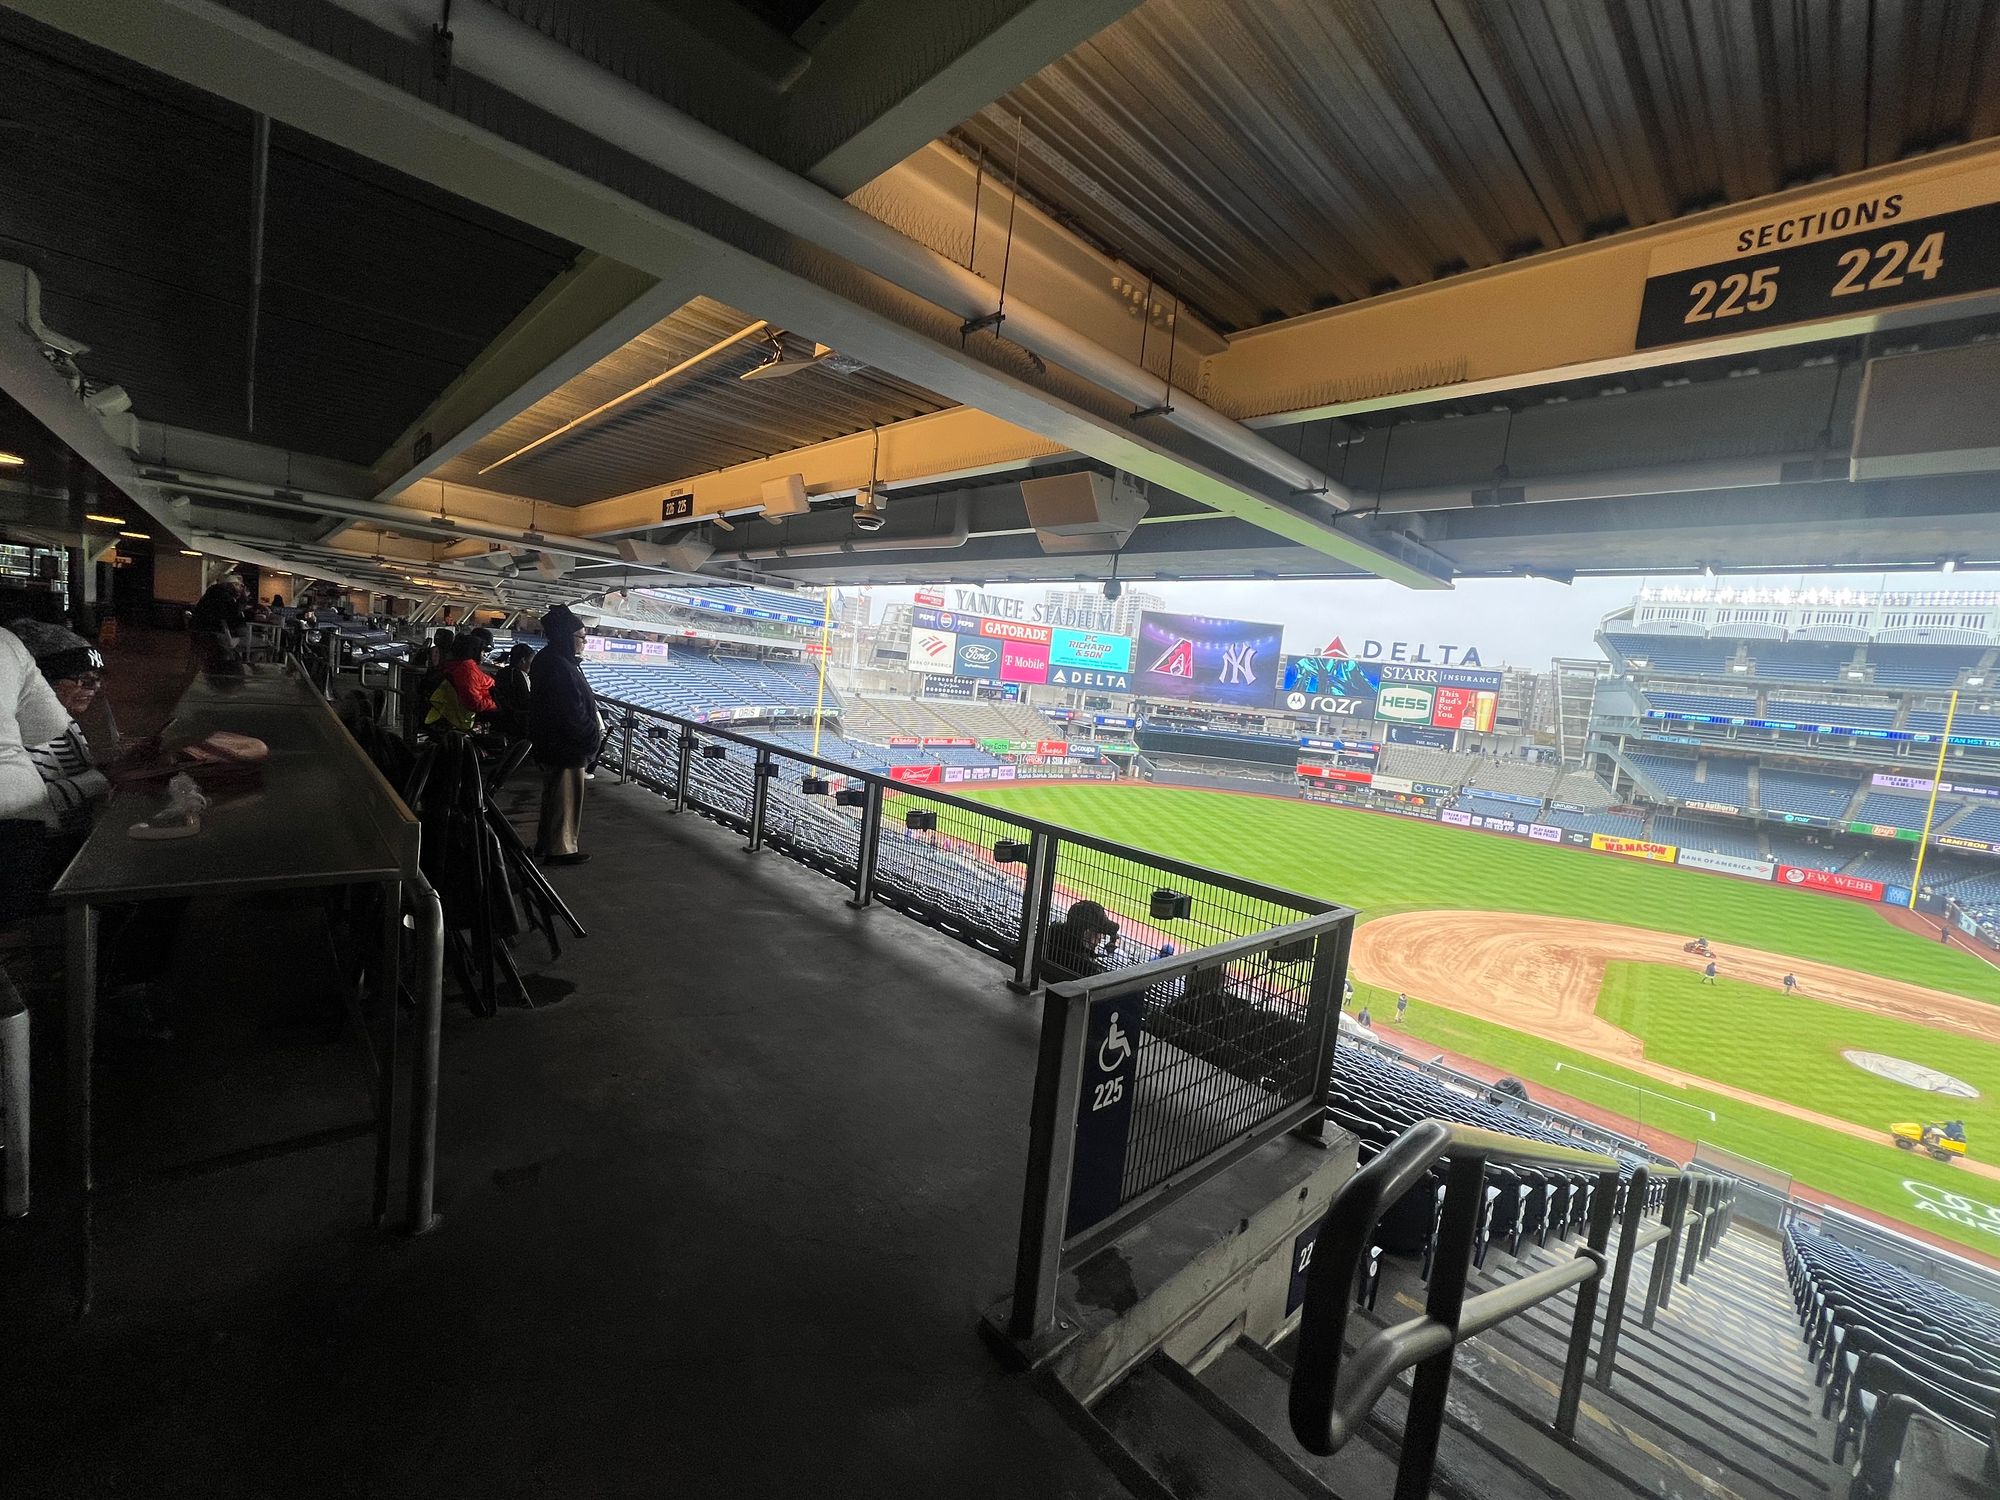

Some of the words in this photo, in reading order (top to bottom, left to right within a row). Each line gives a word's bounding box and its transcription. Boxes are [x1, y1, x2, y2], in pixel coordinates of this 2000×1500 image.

[1737, 194, 1904, 253] SECTIONS
[1684, 266, 1781, 324] 225
[1831, 231, 1946, 298] 224
[918, 613, 936, 622] PEPSI
[955, 589, 1025, 620] YANKEE
[1032, 603, 1113, 632] STADIUM
[957, 619, 975, 628] PEPSI
[984, 622, 1048, 641] GATORADE
[1084, 634, 1098, 643] PC
[1068, 640, 1112, 652] RICHARD
[1363, 640, 1482, 667] DELTA
[87, 648, 104, 668] NY
[965, 646, 991, 662] Ford
[1083, 650, 1103, 659] SON
[1015, 656, 1045, 670] Mobile
[1071, 671, 1127, 688] DELTA
[1382, 665, 1439, 683] STARR
[1443, 674, 1498, 684] INSURANCE
[1439, 689, 1460, 698] This
[1439, 696, 1463, 705] Bud's
[1310, 696, 1362, 715] razr
[1382, 695, 1429, 711] HESS
[1438, 703, 1453, 711] For
[1437, 710, 1455, 719] You.
[1077, 745, 1095, 753] coupa
[1685, 800, 1704, 809] Parts
[1705, 802, 1739, 814] Authority
[1485, 817, 1514, 827] DOWNLOAD
[1503, 825, 1515, 833] APP
[1939, 837, 1988, 850] ARMITRON
[1681, 854, 1702, 862] BANK
[1713, 859, 1752, 871] AMERICA
[1834, 876, 1873, 892] WEBB
[1092, 1075, 1124, 1112] 225
[1298, 1238, 1316, 1273] 22
